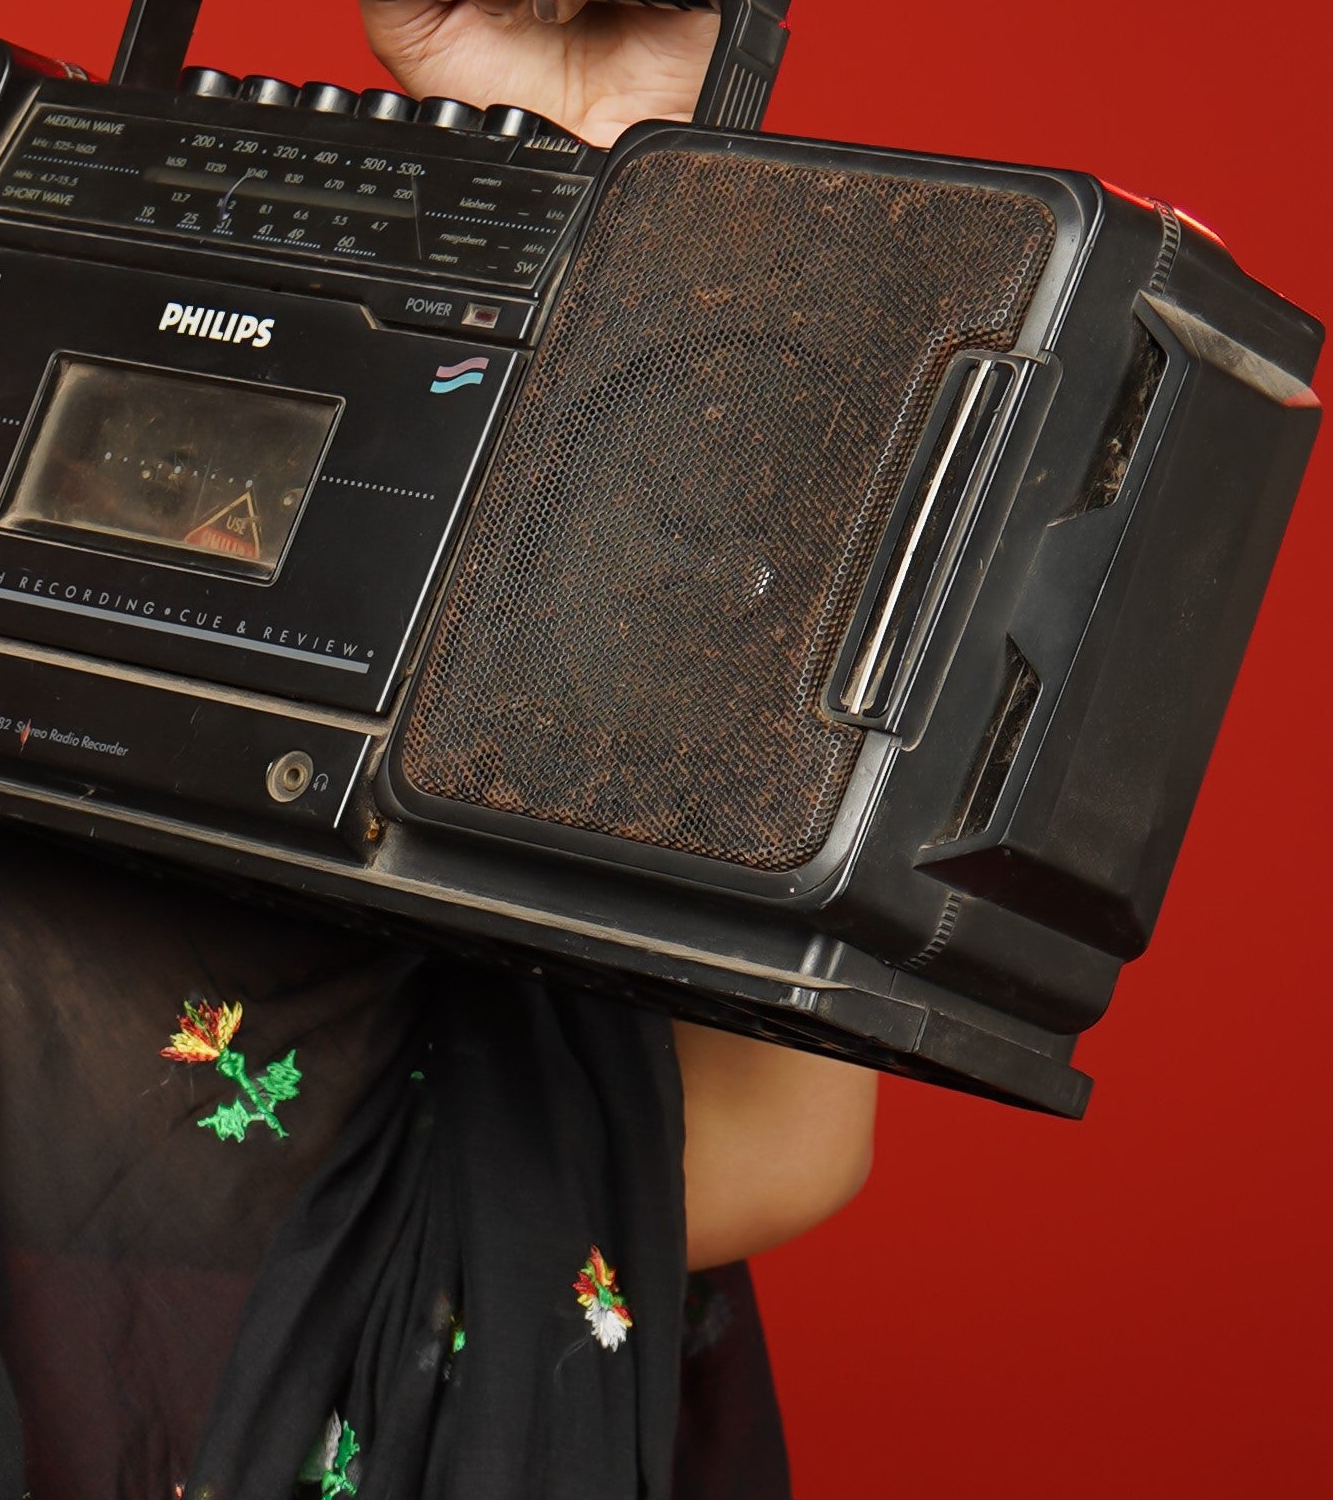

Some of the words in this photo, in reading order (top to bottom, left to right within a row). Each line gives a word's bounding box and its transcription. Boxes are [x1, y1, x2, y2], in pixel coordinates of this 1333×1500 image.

[44, 114, 90, 132] MEDIUM
[92, 122, 126, 135] WAVE
[192, 134, 216, 148] 200
[233, 140, 259, 154] 250
[273, 146, 299, 160] 320
[314, 152, 339, 165] 400
[360, 157, 386, 171] 500
[396, 162, 422, 176] 530
[1, 186, 42, 201] SHORT
[43, 191, 75, 205] WAVE
[165, 156, 187, 168] 1650
[205, 162, 227, 173] 1320
[245, 168, 268, 179] 1040
[285, 173, 303, 184] 830
[325, 179, 345, 190] 670
[357, 183, 377, 195] 590
[393, 188, 413, 199] 520
[552, 184, 582, 196] MW
[141, 206, 155, 218] 19
[182, 212, 199, 224] 25
[258, 224, 273, 235] 41
[287, 229, 305, 240] 49
[337, 236, 356, 248] 60
[514, 261, 539, 275] SW
[405, 298, 453, 316] POWER
[158, 302, 276, 349] PHILIPS
[19, 576, 156, 615] RECORDING
[180, 609, 222, 629] CUE
[236, 621, 247, 634] &
[263, 627, 358, 658] REVIEW
[15, 720, 48, 739] Sreo
[49, 728, 80, 747] Radio
[81, 735, 129, 756] Recorder
